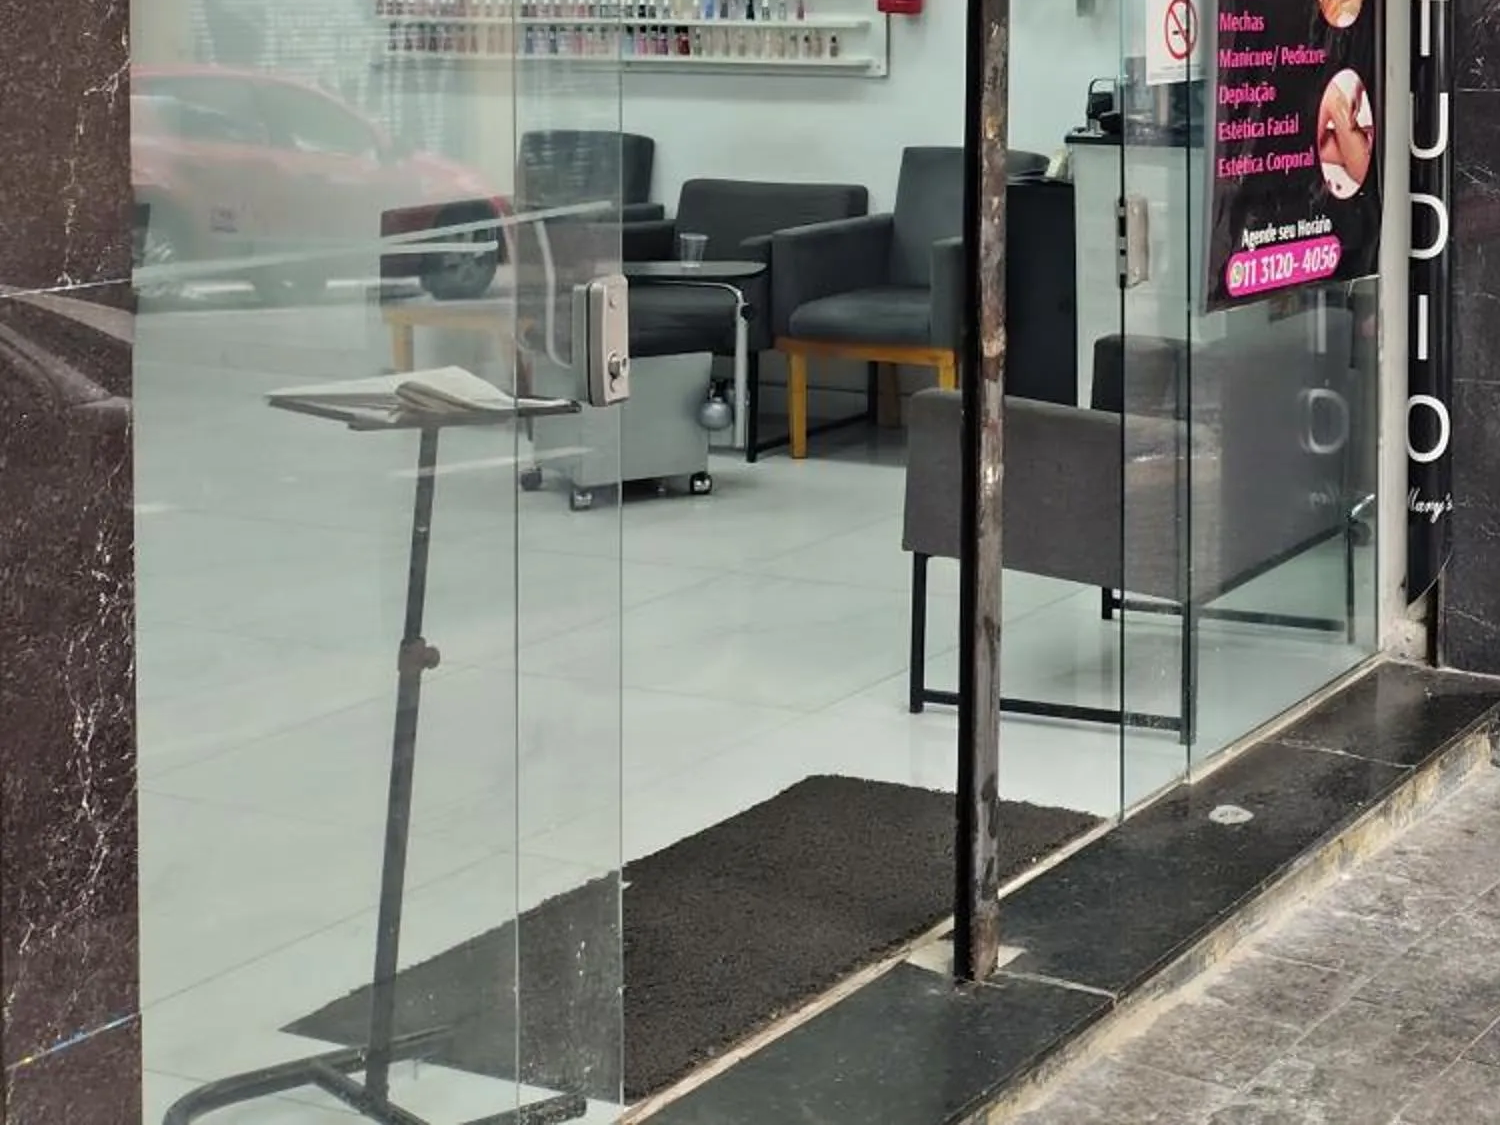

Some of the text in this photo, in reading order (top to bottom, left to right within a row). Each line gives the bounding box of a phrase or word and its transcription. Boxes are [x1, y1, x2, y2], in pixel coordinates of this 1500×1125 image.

[1219, 10, 1265, 32] Mechas
[1281, 44, 1326, 66] Pedicure
[1219, 81, 1276, 110] Depilação
[1218, 112, 1299, 142] Estética Facial
[1218, 145, 1314, 179] Estética Corporal
[1241, 214, 1333, 252] Agende seu Horário
[1302, 243, 1341, 273] 4056
